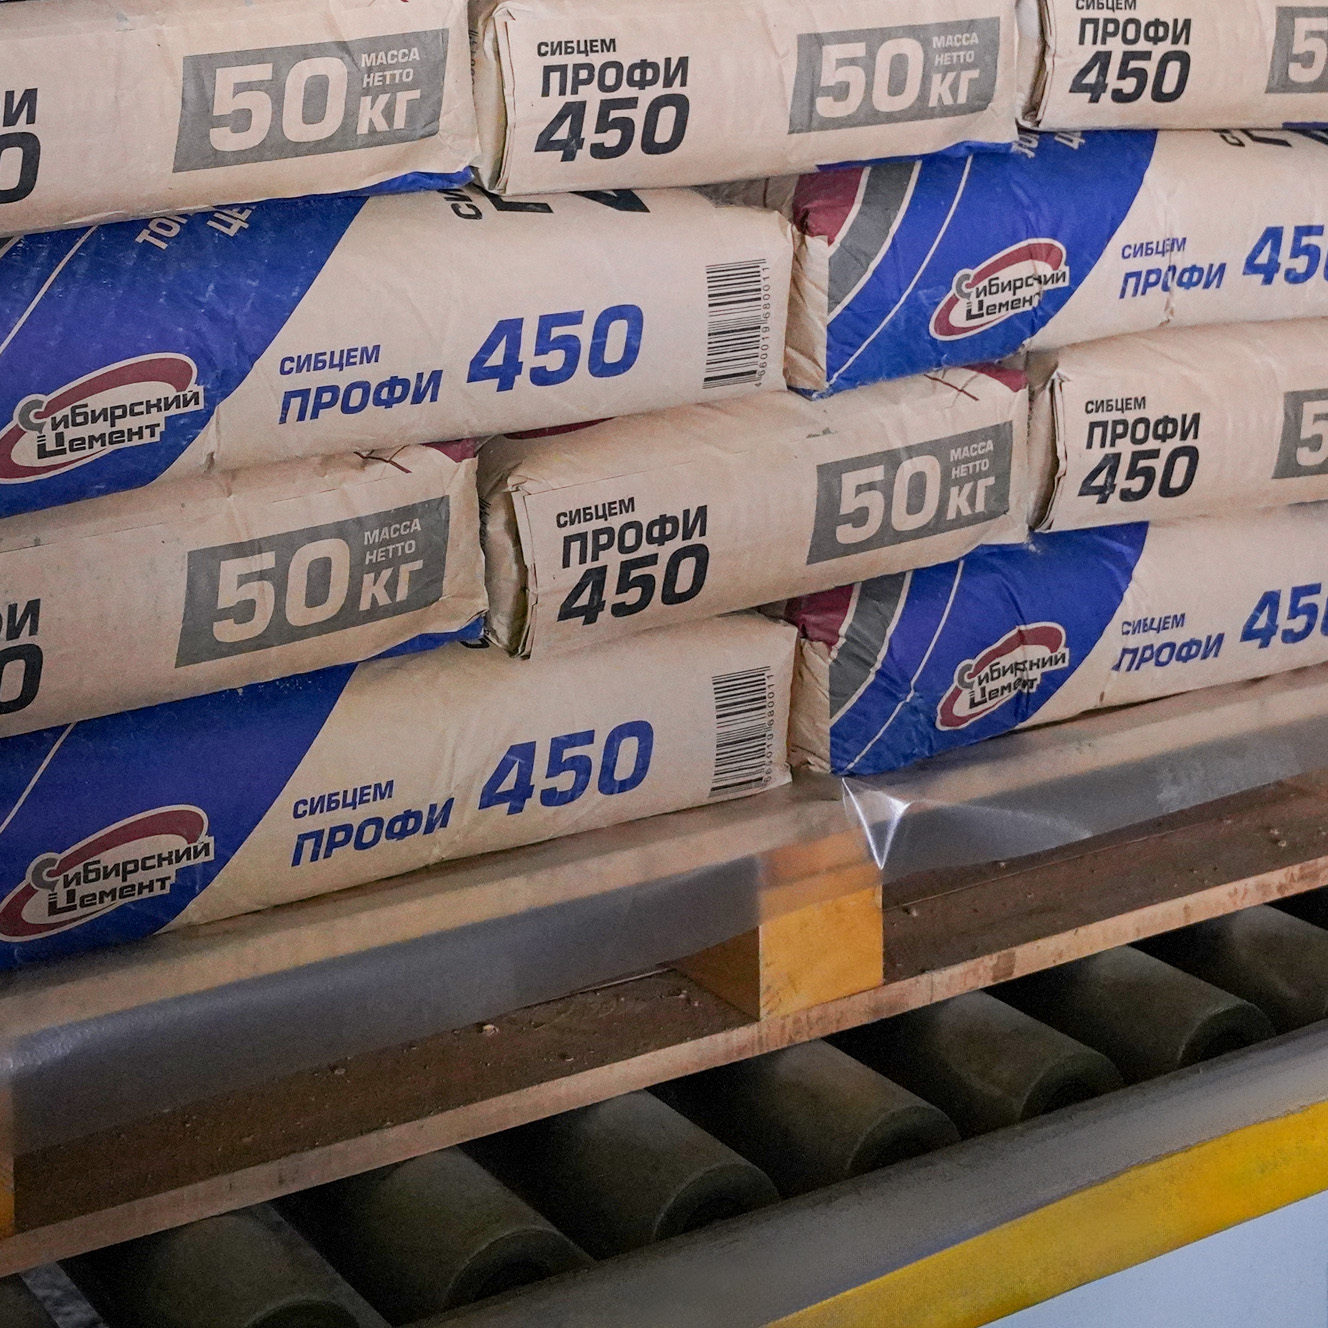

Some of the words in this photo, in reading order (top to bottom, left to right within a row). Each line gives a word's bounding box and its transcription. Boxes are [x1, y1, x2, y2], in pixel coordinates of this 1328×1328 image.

[536, 38, 616, 57] СИБЦЕМ
[933, 32, 979, 48] МАССА
[1078, 18, 1191, 46] ПРОФИ
[361, 47, 420, 68] МАССА
[541, 56, 689, 97] ПРОФИ
[935, 50, 975, 65] НЕТТО
[1069, 49, 1191, 104] 450
[362, 68, 413, 87] НЕТТО
[815, 37, 924, 119] 50
[928, 69, 980, 108] КГ
[208, 56, 346, 152] 50
[356, 89, 421, 135] КГ
[534, 93, 690, 162] 450
[279, 345, 380, 376] СИБЦЕМ
[279, 369, 443, 424] ПРОФИ
[466, 304, 644, 392] 450
[17, 388, 200, 433] Сибирский
[1085, 396, 1146, 414] СИБЦЕМ
[37, 420, 161, 458] Цемент
[1086, 412, 1200, 450] ПРОФИ
[950, 440, 994, 463] МАССА
[952, 458, 990, 480] НЕТТО
[1078, 446, 1199, 504] 450
[556, 497, 635, 528] СИБЦЕМ
[835, 455, 940, 545] 50
[947, 476, 995, 521] КГ
[364, 518, 421, 543] МАССА
[562, 505, 708, 568] ПРОФИ
[365, 538, 416, 565] НЕТТО
[212, 538, 350, 643] 50
[359, 560, 423, 611] КГ
[557, 543, 709, 626] 450
[1112, 633, 1224, 673] ПРОФИ
[291, 798, 454, 867] ПРОФИ
[478, 720, 653, 816] 450
[293, 780, 394, 819] СИБЦЕМ
[31, 839, 211, 889] Сибирский
[48, 875, 171, 917] Цемент
